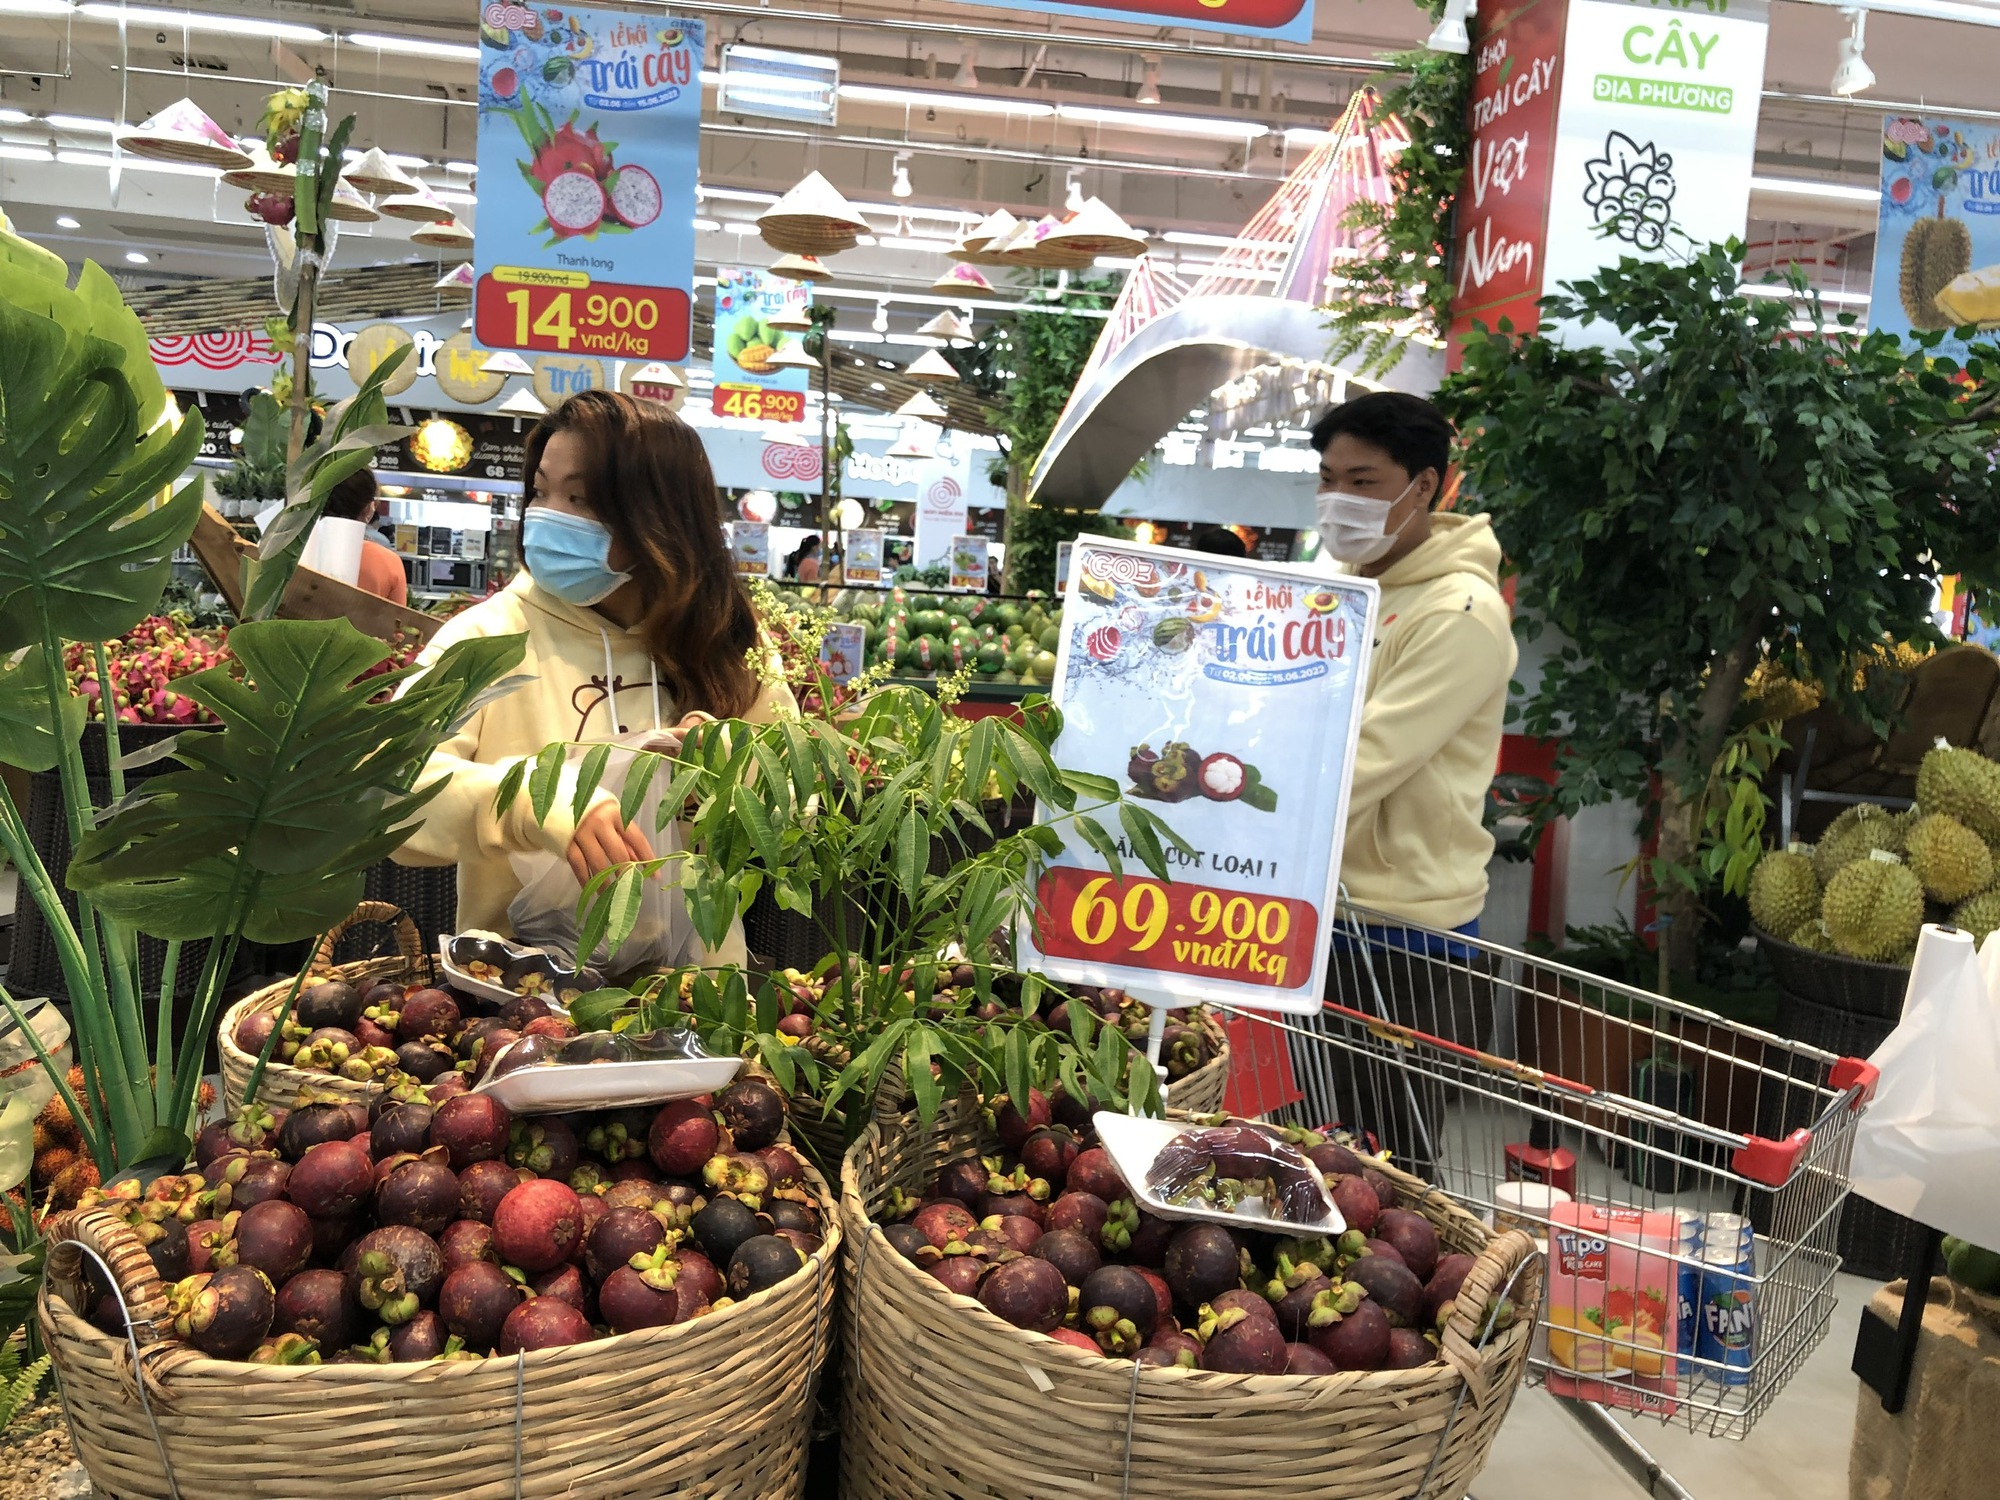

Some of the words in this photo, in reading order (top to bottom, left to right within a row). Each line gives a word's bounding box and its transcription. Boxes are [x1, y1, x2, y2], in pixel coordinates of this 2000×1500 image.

[1622, 18, 1720, 70] CÂY
[580, 49, 639, 93] Trái
[1595, 78, 1633, 103] ĐỊA
[1638, 82, 1731, 110] PHƯƠNG
[556, 253, 589, 268] Thanh
[590, 257, 614, 272] long
[1458, 215, 1534, 299] Nam
[1086, 551, 1155, 584] GO!
[1264, 585, 1293, 614] hội
[1203, 614, 1276, 663] Trái
[1212, 853, 1263, 879] LOẠI
[1269, 861, 1278, 879] 1
[1556, 1233, 1607, 1259] Tipo
